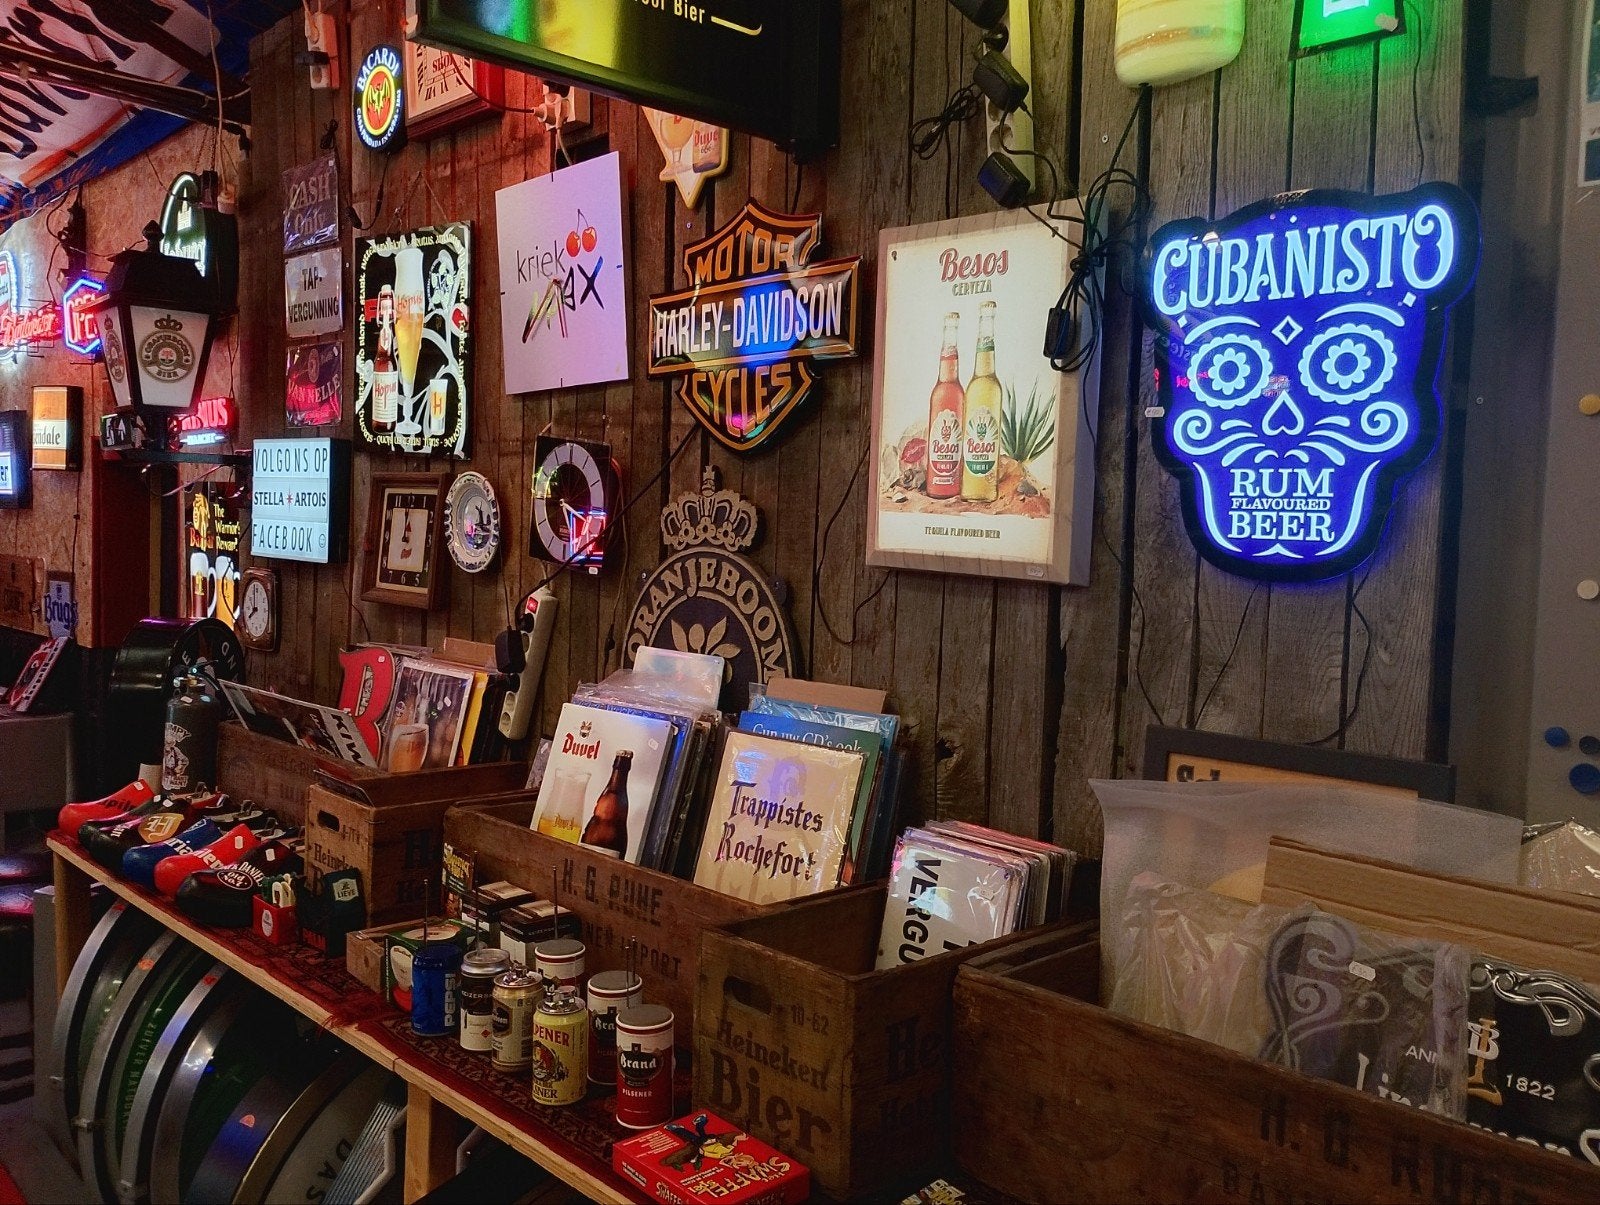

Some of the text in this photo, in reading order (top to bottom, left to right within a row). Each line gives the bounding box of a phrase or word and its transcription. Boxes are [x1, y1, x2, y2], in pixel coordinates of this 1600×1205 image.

[356, 47, 400, 92] BACARDI
[290, 172, 331, 211] CASH
[517, 240, 566, 284] kriek
[696, 219, 797, 284] MOTOR
[939, 247, 1009, 283] Besos
[1153, 204, 1454, 315] CUBANISTO
[951, 280, 992, 297] CERVEZA
[288, 296, 339, 324] VERGUNNING
[655, 282, 843, 358] HARLEY-DAVIDSON
[309, 374, 341, 404] NELLE
[692, 362, 792, 438] CYCLES
[314, 447, 328, 473] OP
[966, 438, 995, 454] Besos
[1229, 467, 1334, 498] RUM
[214, 503, 225, 518] The
[254, 490, 327, 507] STELLA ARTOIS
[1230, 498, 1331, 510] FLAVOURED
[252, 522, 312, 553] FACEBOOK
[924, 526, 1001, 539] TEQUILA FLAVOURED BEER
[1228, 511, 1335, 542] BEER
[627, 558, 786, 680] ORANJEBOOM
[561, 732, 600, 760] Duvel
[730, 779, 823, 832] Trappistes
[584, 866, 598, 905] G.
[444, 973, 456, 1027] PEPSI
[595, 1016, 616, 1031] Bra
[620, 1052, 657, 1070] Brand
[622, 1088, 653, 1098] PILSENER
[710, 1047, 832, 1155] Bier
[1505, 1073, 1556, 1101] 1822
